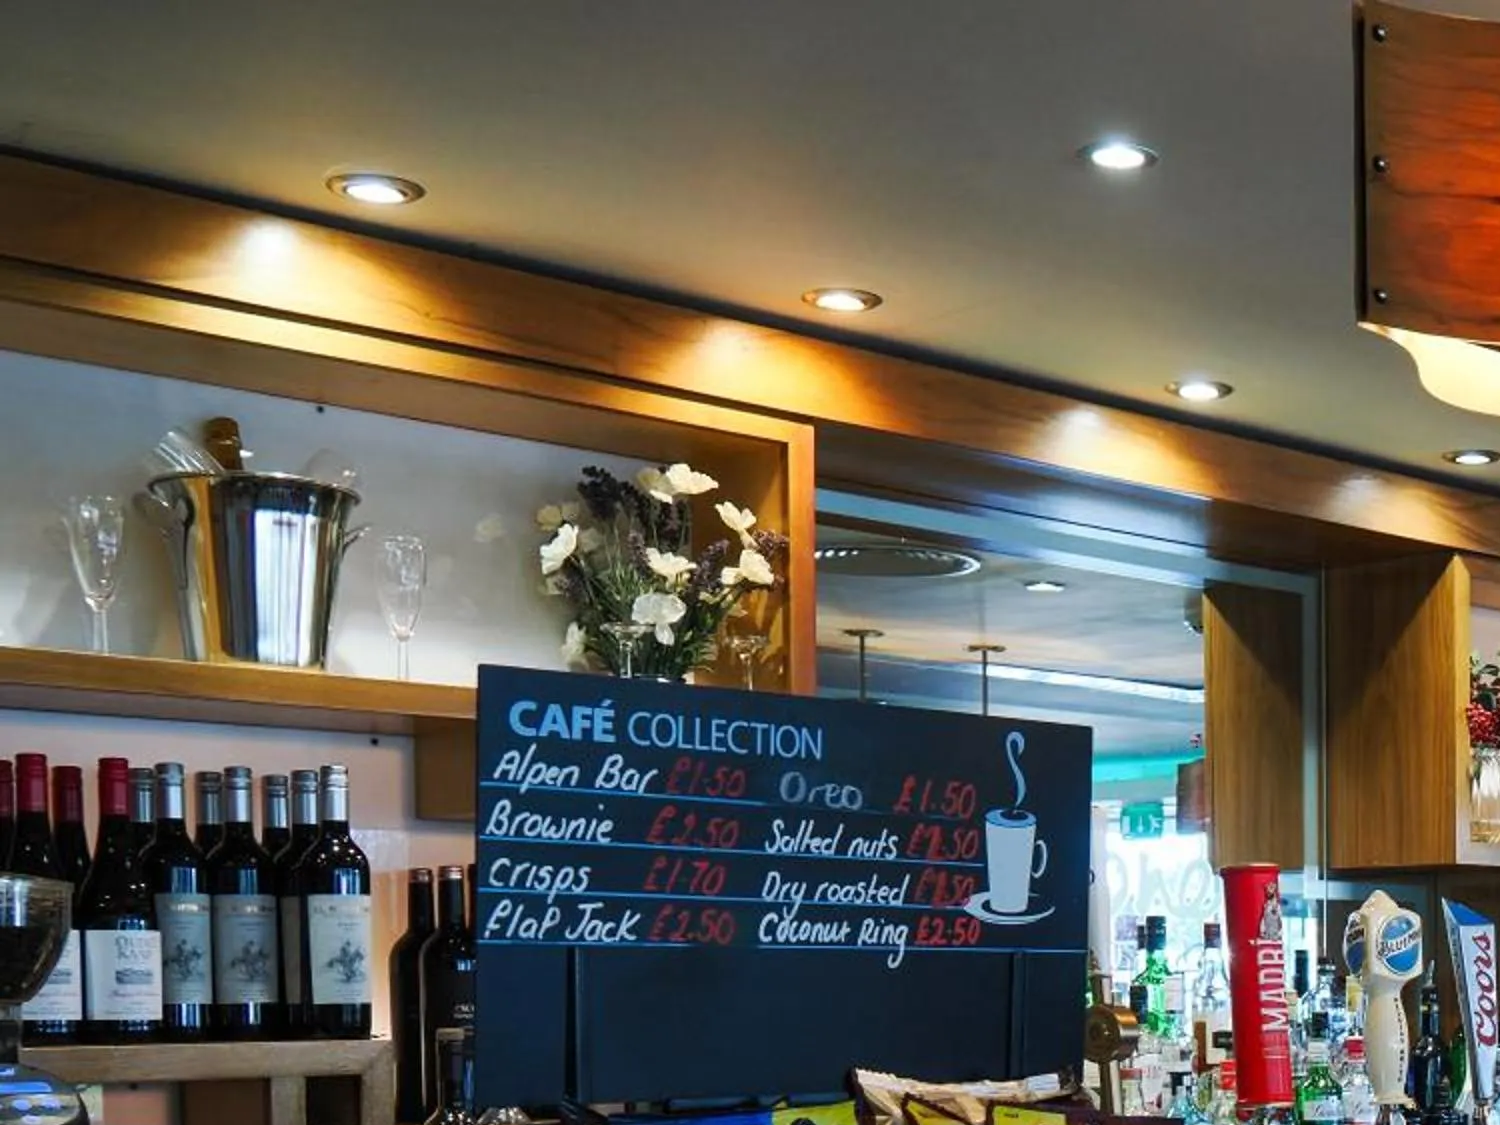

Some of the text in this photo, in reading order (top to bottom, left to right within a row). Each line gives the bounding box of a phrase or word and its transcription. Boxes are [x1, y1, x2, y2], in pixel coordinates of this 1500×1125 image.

[509, 700, 822, 760] CAFÉ COLLECTION
[493, 743, 746, 797] Alpen Bar £1.50
[779, 771, 976, 819] Oreo £1.50
[485, 799, 740, 849] Brownie £2.50
[765, 819, 845, 858] Salted
[848, 828, 899, 860] nuts
[643, 856, 727, 895] £1.70
[762, 871, 806, 920] Dry
[815, 874, 910, 905] roasted
[647, 904, 737, 945] £2.50
[758, 912, 981, 969] Coconut Ring £2.50
[1472, 932, 1498, 1047] Coors
